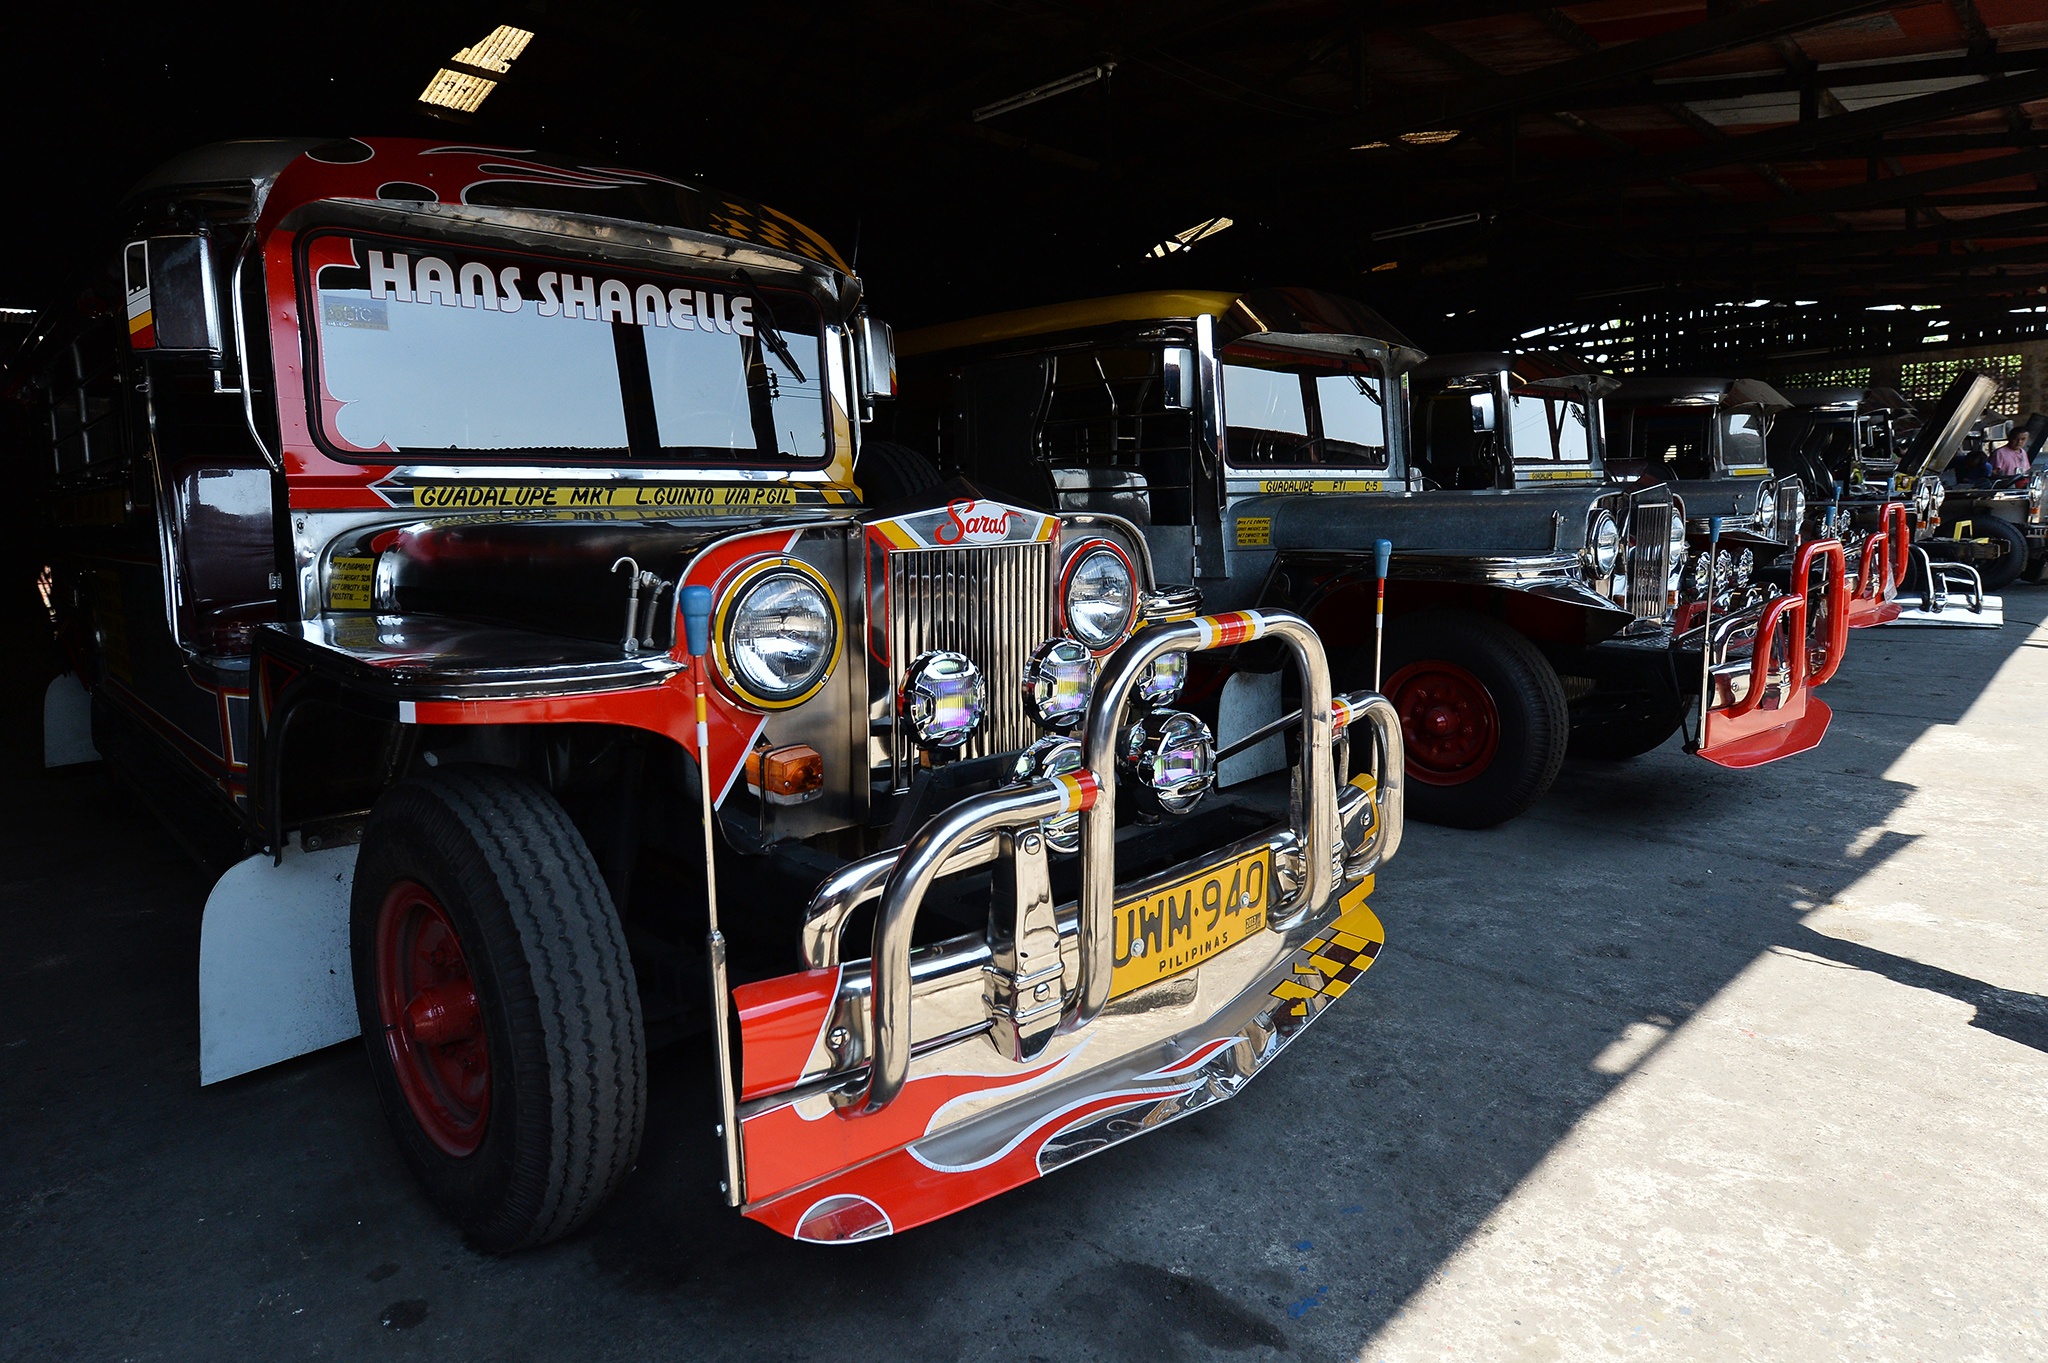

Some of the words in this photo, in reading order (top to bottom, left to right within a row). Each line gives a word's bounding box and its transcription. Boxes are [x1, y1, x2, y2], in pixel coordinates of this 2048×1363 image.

[368, 250, 523, 313] HANS
[537, 271, 755, 337] SHANELLE
[420, 486, 557, 507] GUADALUPE
[569, 487, 617, 506] MKT
[724, 487, 750, 506] VIA
[1266, 481, 1314, 492] GUADALUPE
[1332, 481, 1346, 491] FTI
[933, 497, 1027, 546] Saras
[1159, 931, 1229, 973] PILIPINAS
